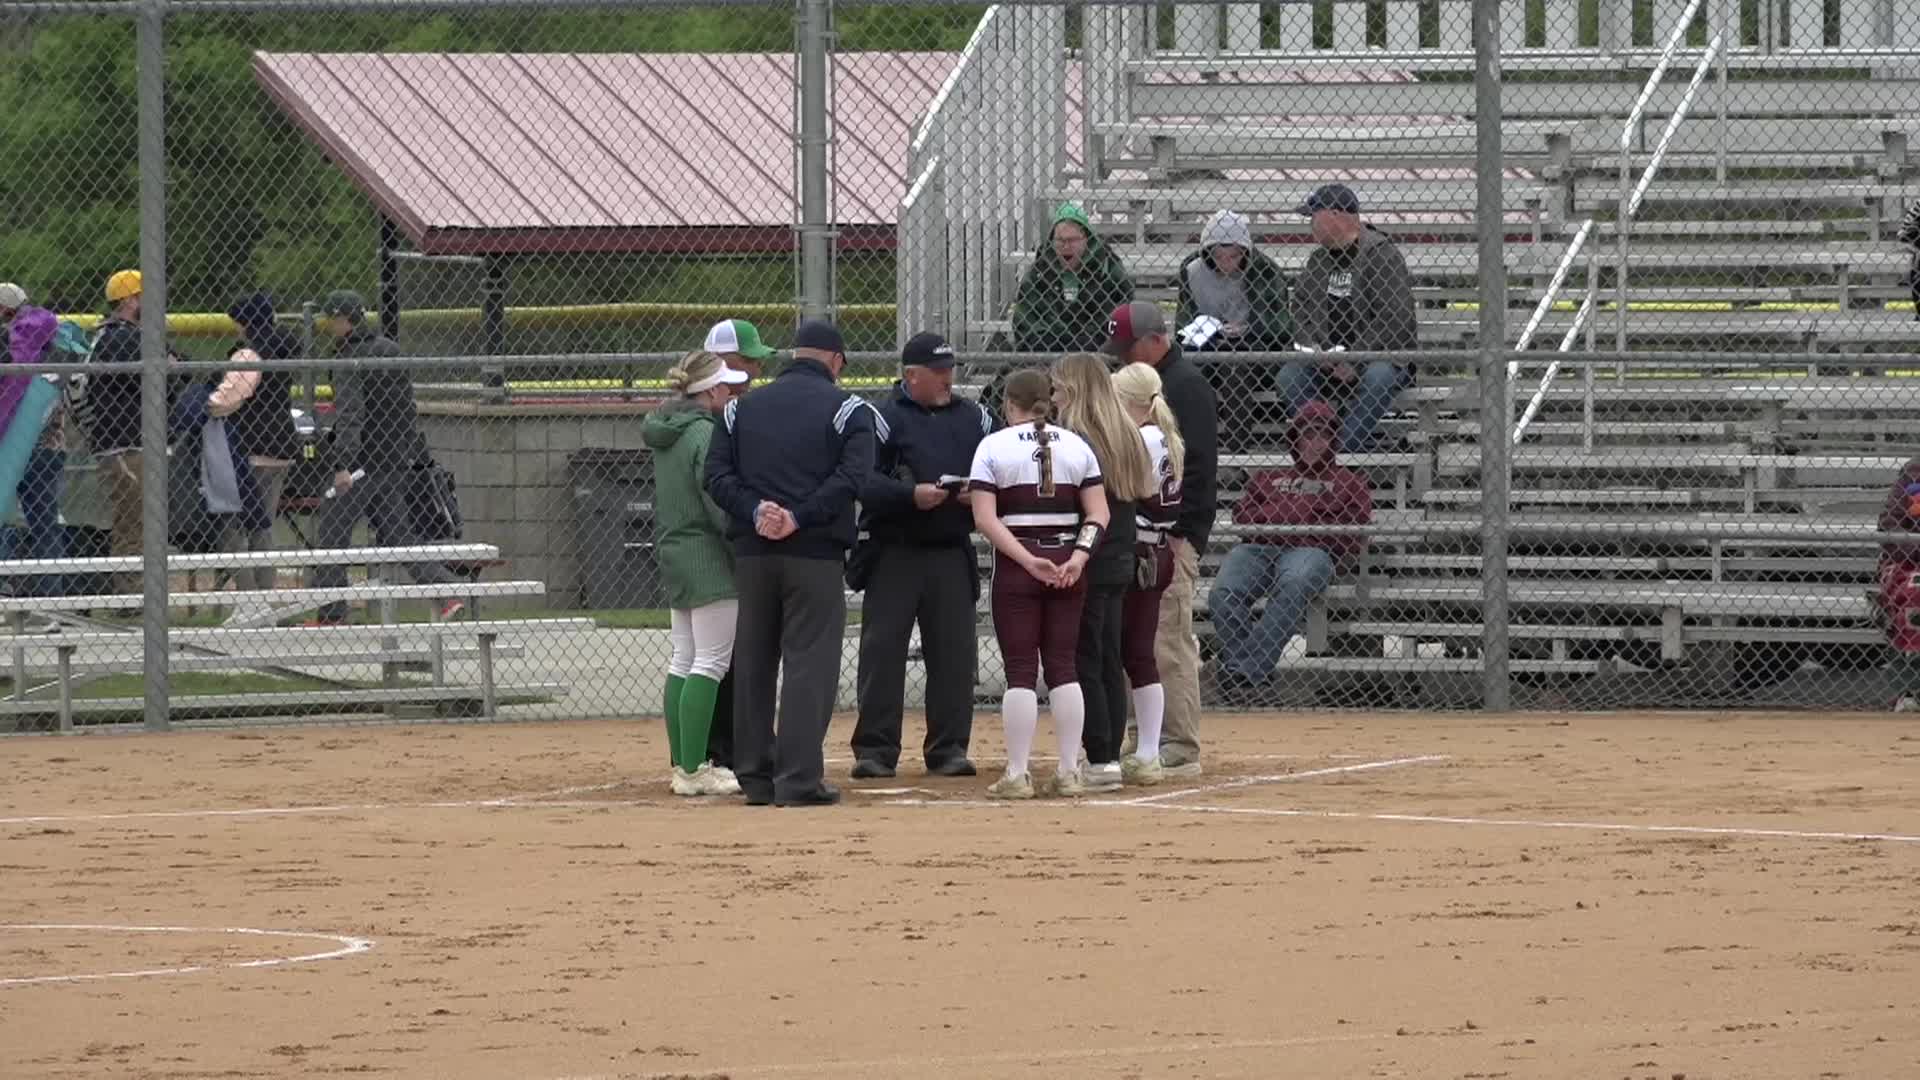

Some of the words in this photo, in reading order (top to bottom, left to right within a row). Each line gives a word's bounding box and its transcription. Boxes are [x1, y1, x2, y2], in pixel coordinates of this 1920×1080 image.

[1107, 320, 1117, 335] C
[1018, 431, 1060, 442] KARER
[1032, 447, 1056, 497] 1
